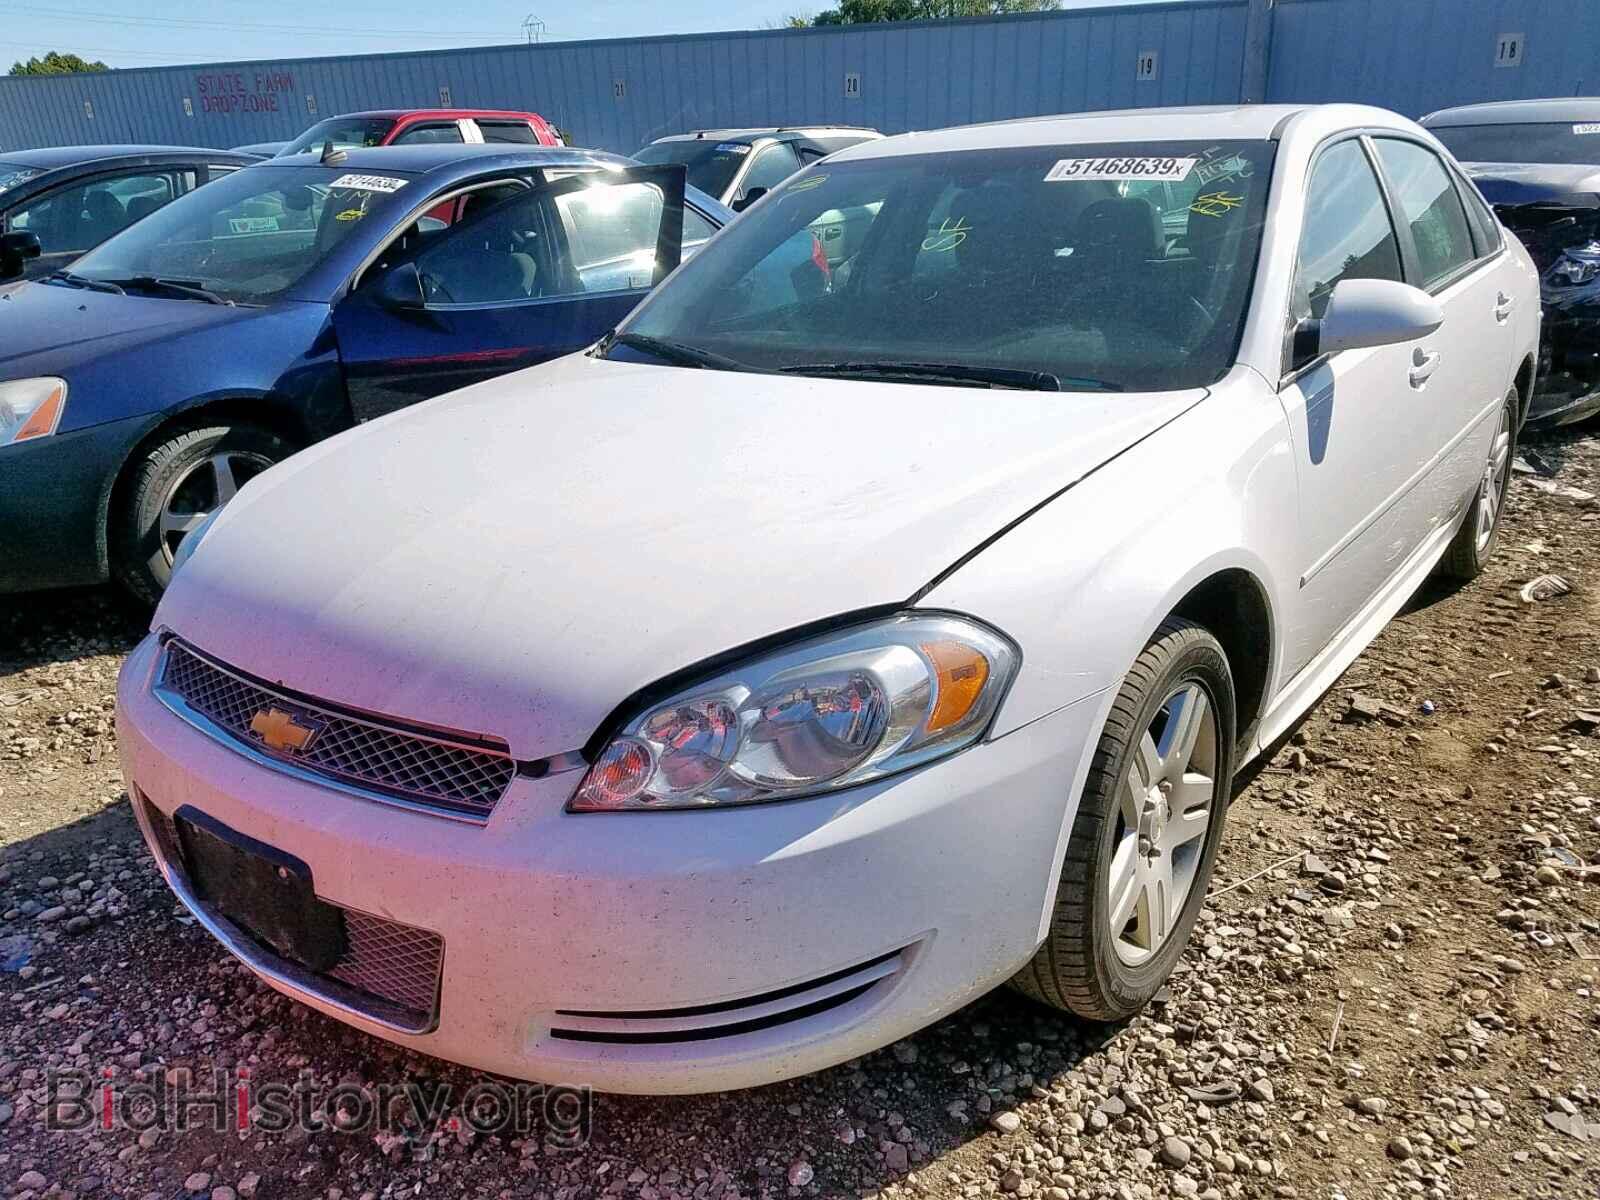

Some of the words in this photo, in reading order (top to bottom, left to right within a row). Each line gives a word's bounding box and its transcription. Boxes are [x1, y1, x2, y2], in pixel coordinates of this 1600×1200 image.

[1500, 41, 1517, 60] 18
[1140, 57, 1153, 74] 19
[199, 72, 245, 93] STATE
[256, 71, 295, 92] FARM
[847, 77, 858, 93] 20
[202, 94, 280, 113] DROPZONE
